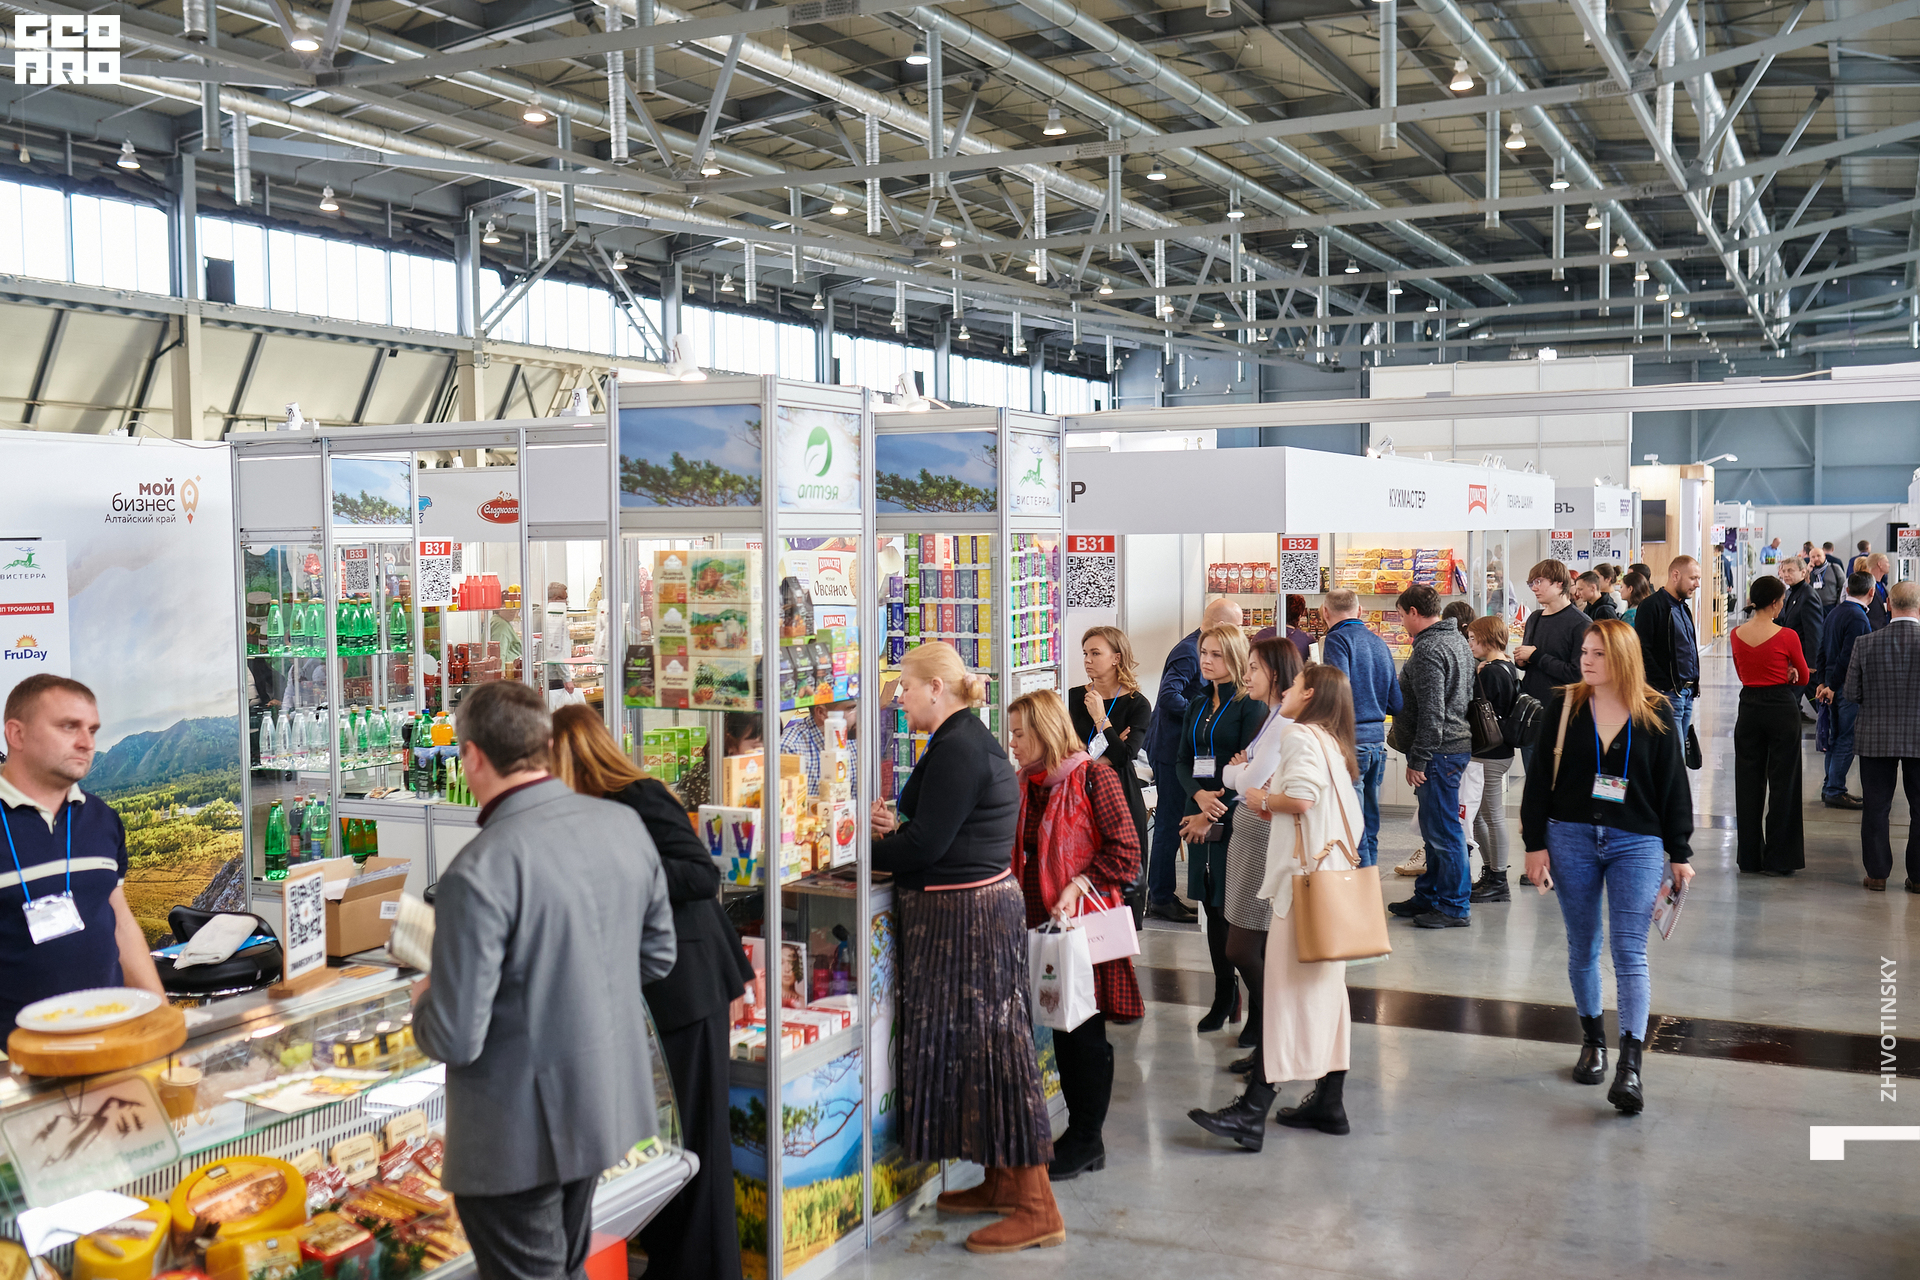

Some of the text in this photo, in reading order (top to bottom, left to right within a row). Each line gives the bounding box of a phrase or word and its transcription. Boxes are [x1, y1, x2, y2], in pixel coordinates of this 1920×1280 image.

[138, 477, 175, 496] мой
[1066, 481, 1087, 503] Р
[112, 492, 176, 512] бизнес
[1016, 494, 1051, 507] ВИСТЕРРА
[1388, 487, 1427, 510] КУХМАСТЕР
[104, 513, 177, 526] Алтайский край
[424, 542, 445, 555] B31
[1076, 536, 1105, 551] B31
[1288, 538, 1312, 550] B32
[349, 549, 364, 559] B33
[0, 572, 47, 580] ВИСТЕРРА
[6, 605, 41, 614] ТРОФИМОВ
[4, 648, 48, 661] FruDay
